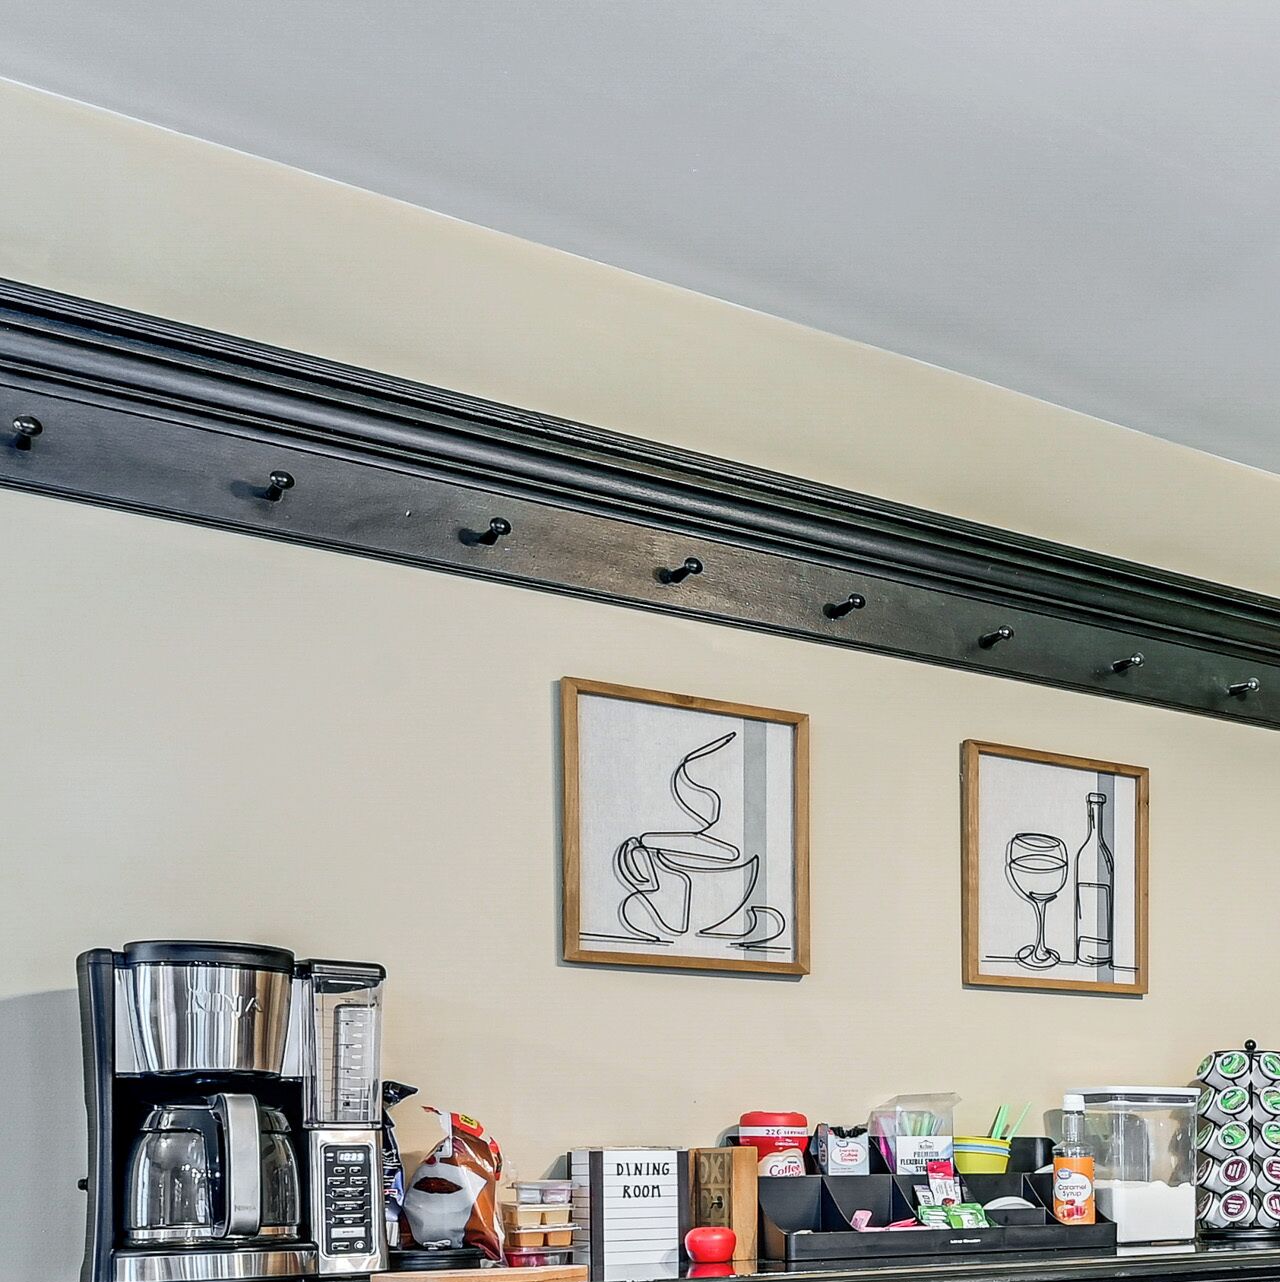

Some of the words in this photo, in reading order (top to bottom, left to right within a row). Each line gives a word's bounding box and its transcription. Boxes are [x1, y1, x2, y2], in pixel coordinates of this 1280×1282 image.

[616, 1162, 670, 1176] DINING
[622, 1185, 662, 1198] ROOM
[1057, 1183, 1087, 1191] Caramel
